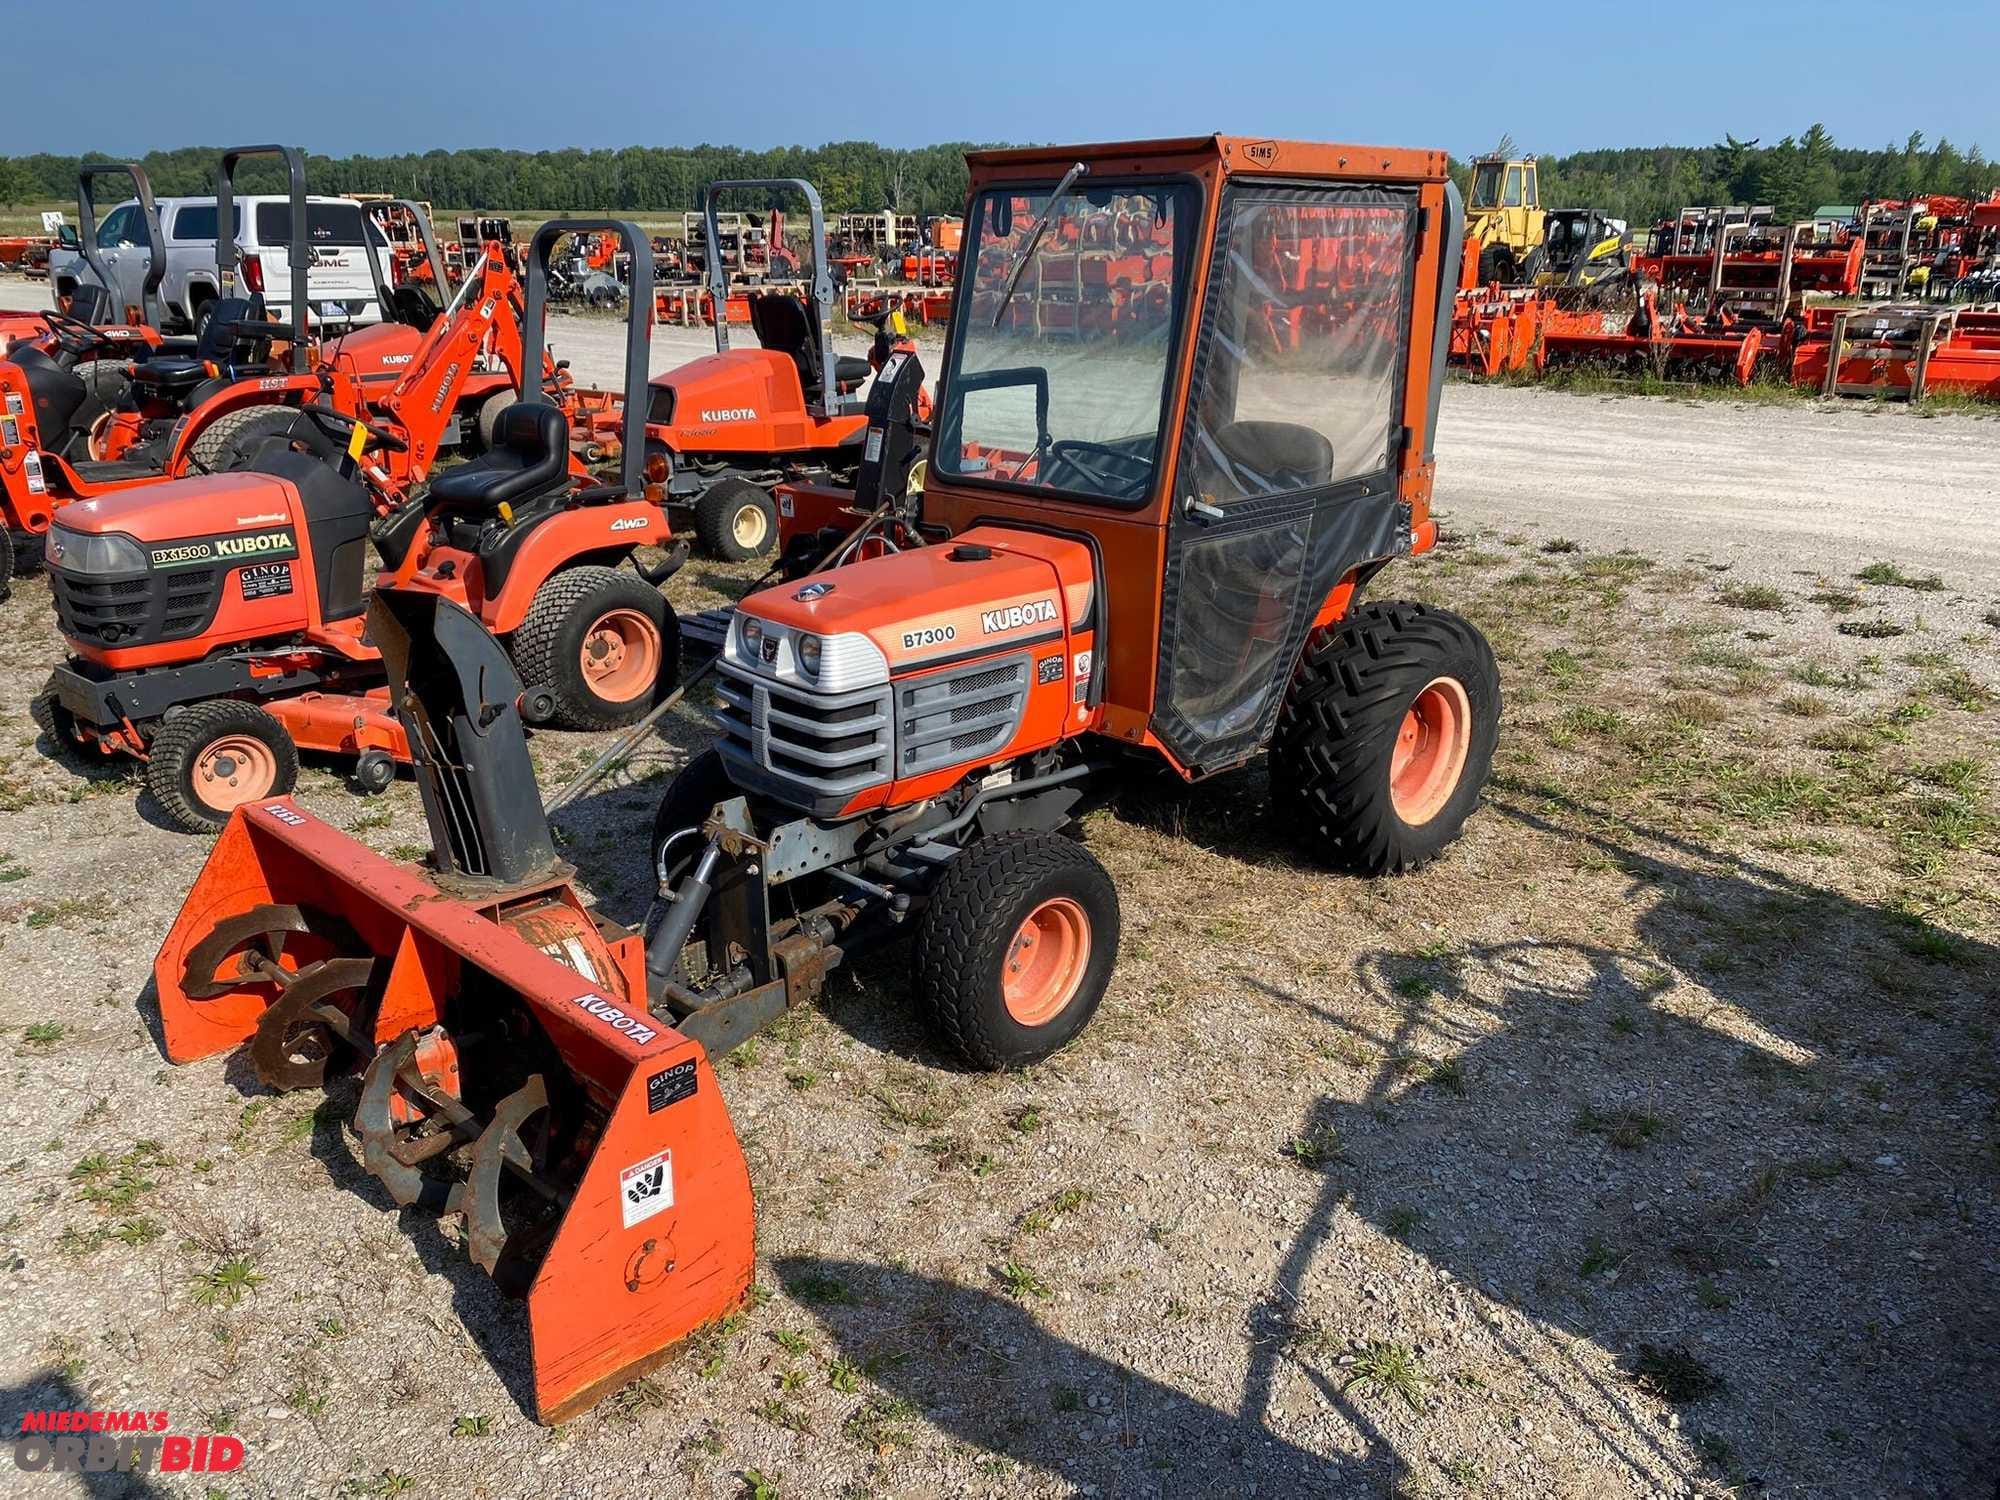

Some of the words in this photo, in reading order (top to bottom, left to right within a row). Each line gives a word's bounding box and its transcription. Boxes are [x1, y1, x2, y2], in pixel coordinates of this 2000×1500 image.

[1250, 146, 1272, 159] SIMS
[312, 259, 350, 267] GMC
[432, 362, 459, 413] KUBOTA
[701, 408, 757, 423] KUBOTA
[609, 517, 649, 531] 4WD
[151, 544, 210, 563] BX1500
[214, 533, 293, 556] KUBOTA
[241, 565, 289, 581] GINOP
[981, 599, 1059, 634] KUBOTA
[903, 625, 956, 648] B7300
[571, 993, 659, 1046] KUBOTA
[649, 1063, 695, 1090] GINOP
